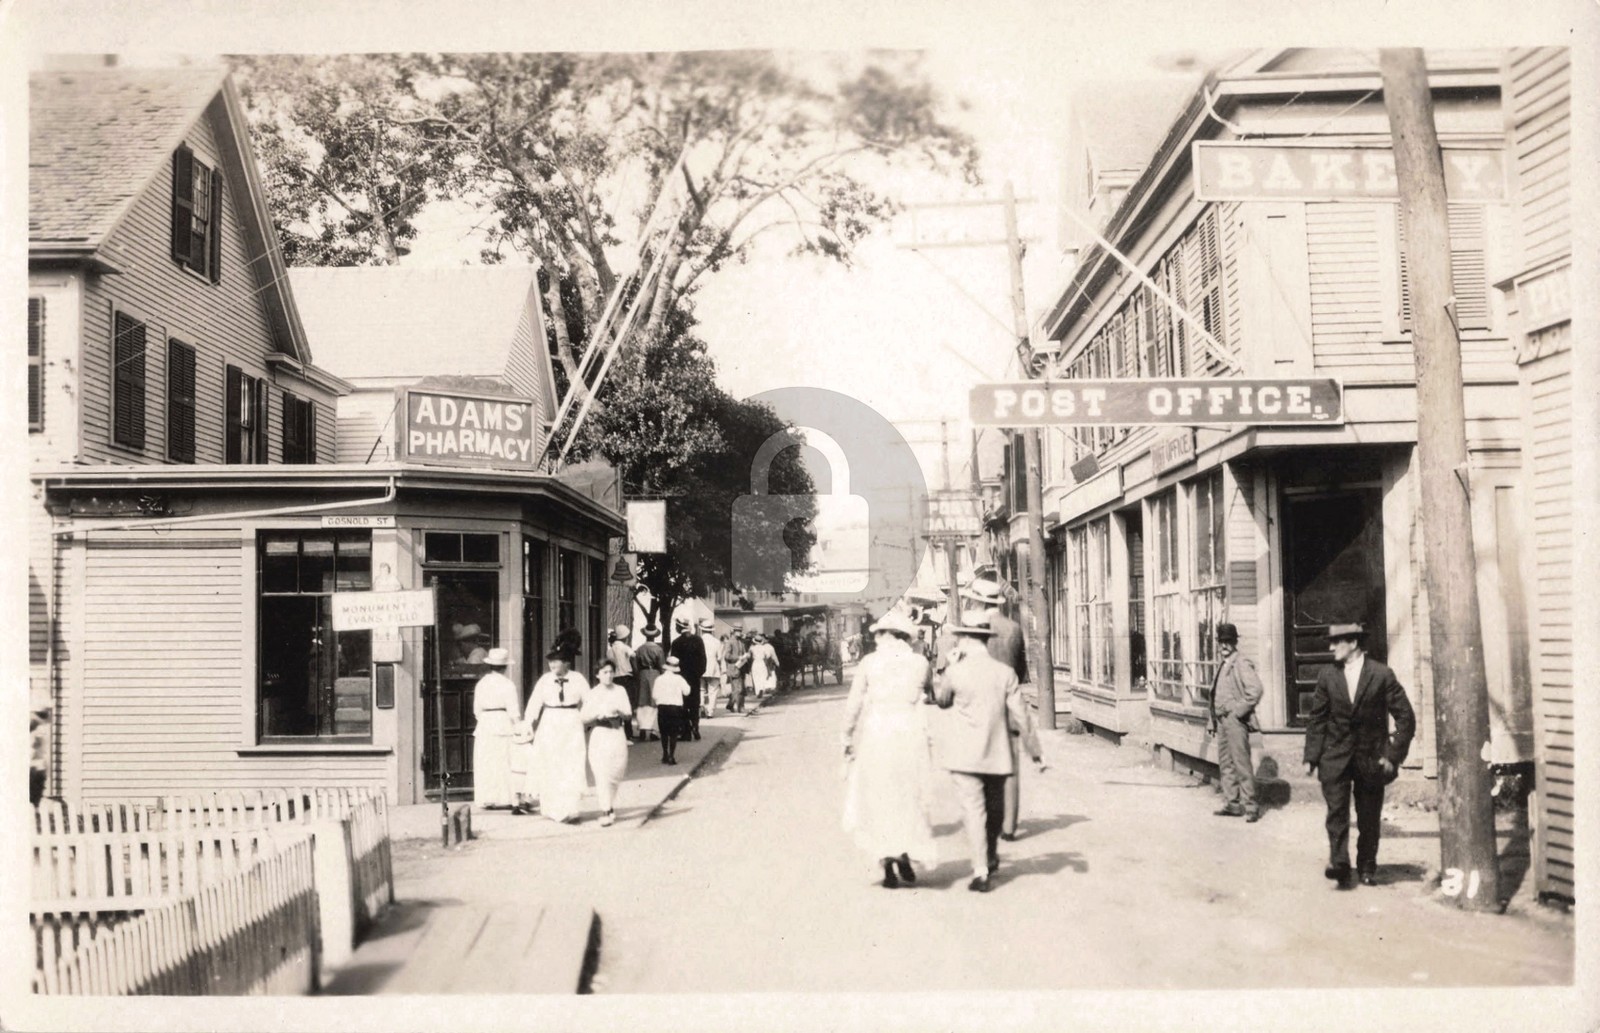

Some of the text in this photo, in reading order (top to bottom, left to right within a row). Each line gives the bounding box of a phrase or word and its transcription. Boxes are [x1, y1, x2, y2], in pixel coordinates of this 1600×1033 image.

[1217, 151, 1497, 191] BAKEY.
[415, 396, 527, 432] ADAMS'
[993, 388, 1106, 418] POST
[409, 429, 531, 462] PHARMACY
[327, 516, 389, 526] GOSNOLD ST
[342, 602, 407, 614] MONUMENT
